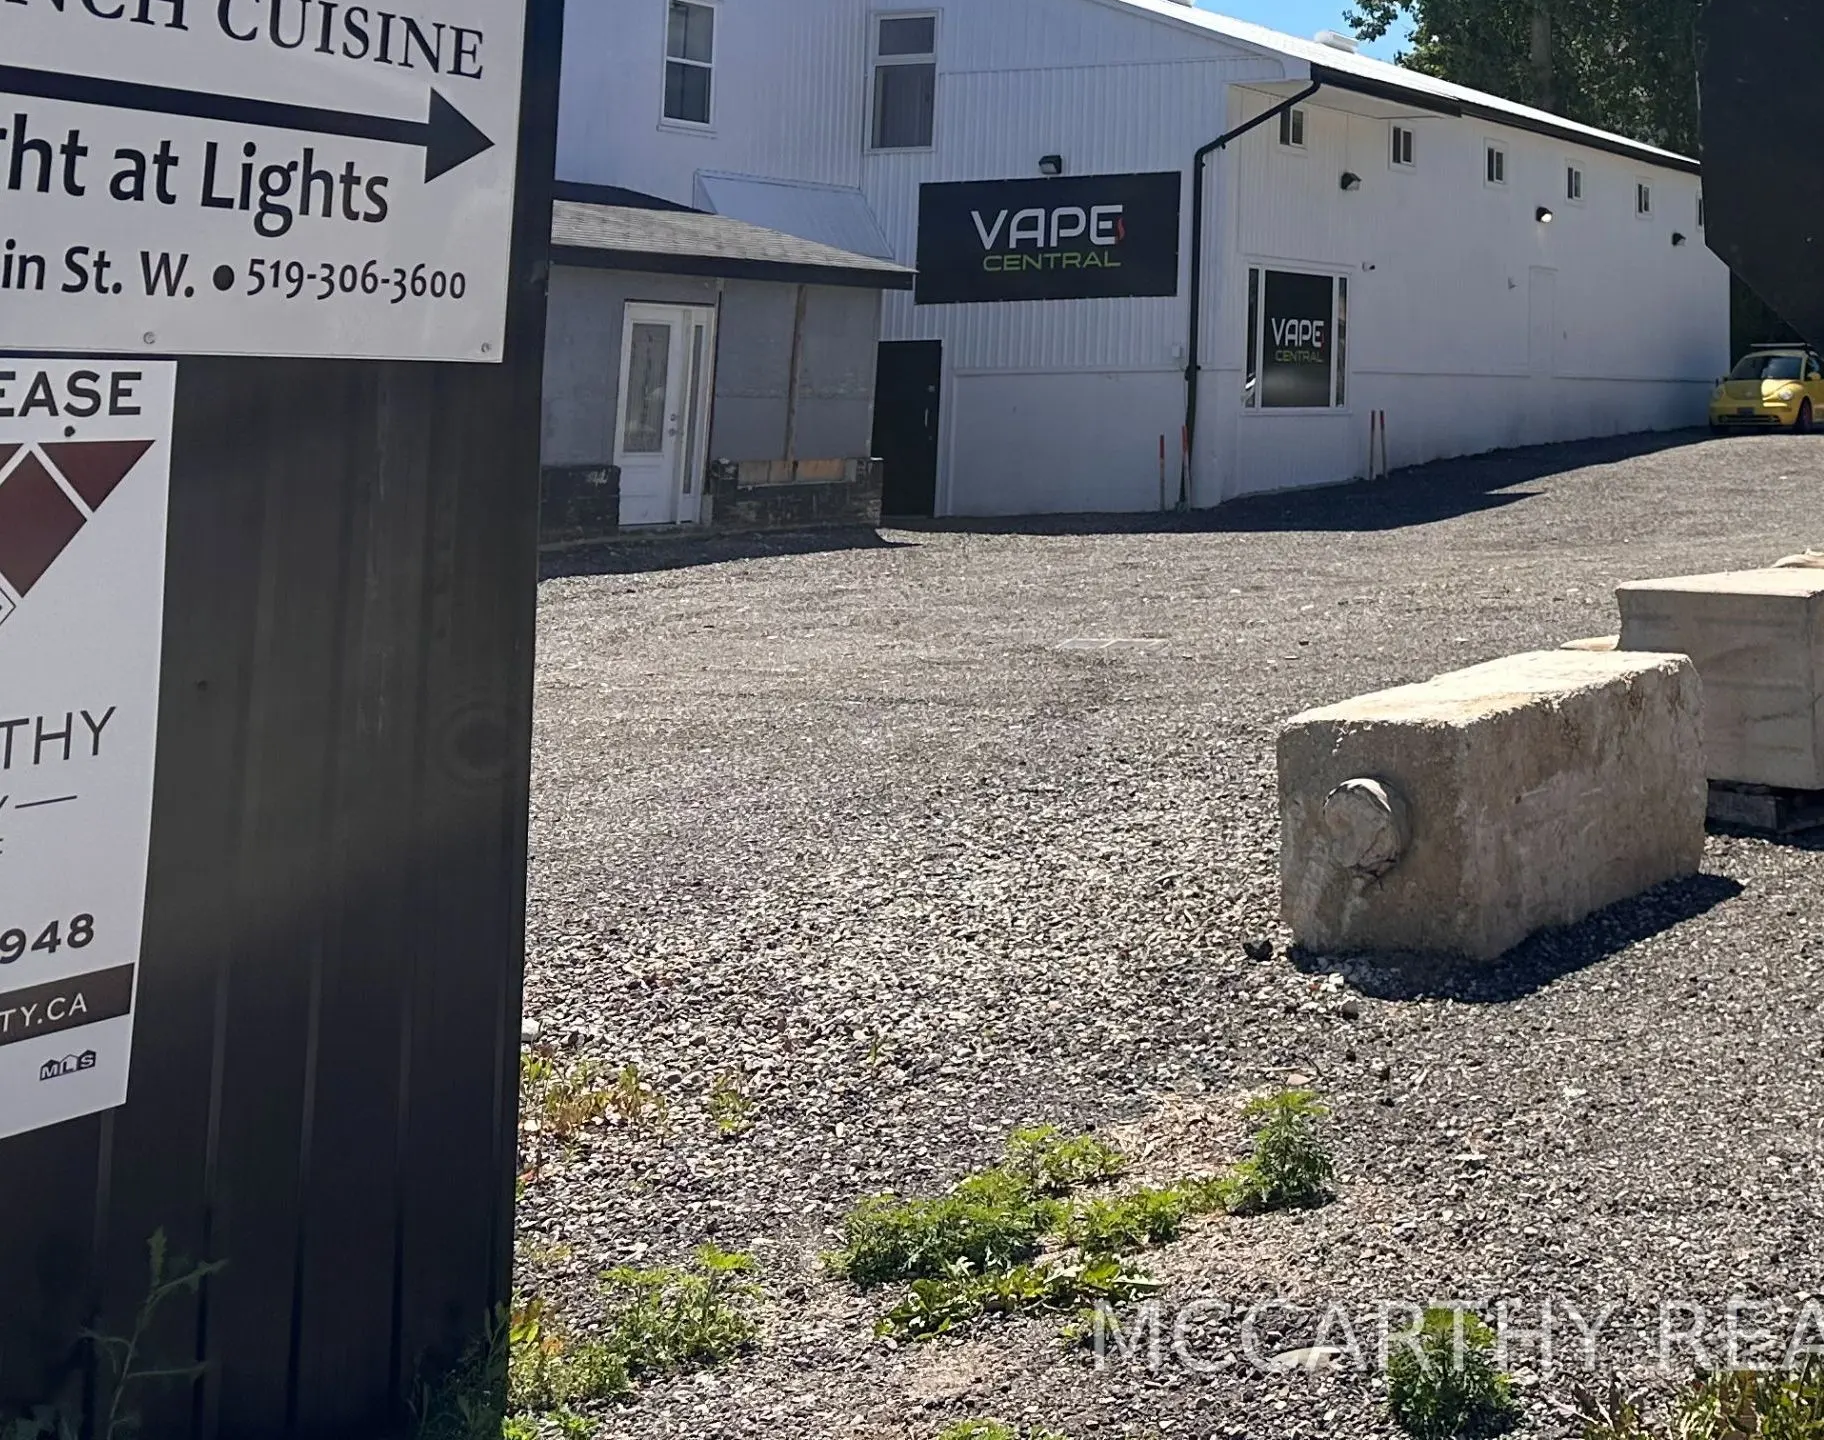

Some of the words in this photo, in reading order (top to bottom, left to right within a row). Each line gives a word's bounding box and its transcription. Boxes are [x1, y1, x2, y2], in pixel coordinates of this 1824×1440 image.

[0, 113, 88, 197] ht
[109, 140, 179, 205] at
[201, 142, 389, 238] Lights
[971, 205, 1123, 250] VAPE
[61, 246, 122, 295] St.
[141, 250, 194, 298] W.
[246, 258, 466, 304] 519-306-3600
[983, 250, 1122, 272] CENTRAL
[1271, 318, 1324, 347] VAPE
[1275, 350, 1324, 363] CENTRAL
[0, 706, 116, 770] THY
[40, 1050, 96, 1081] MLS
